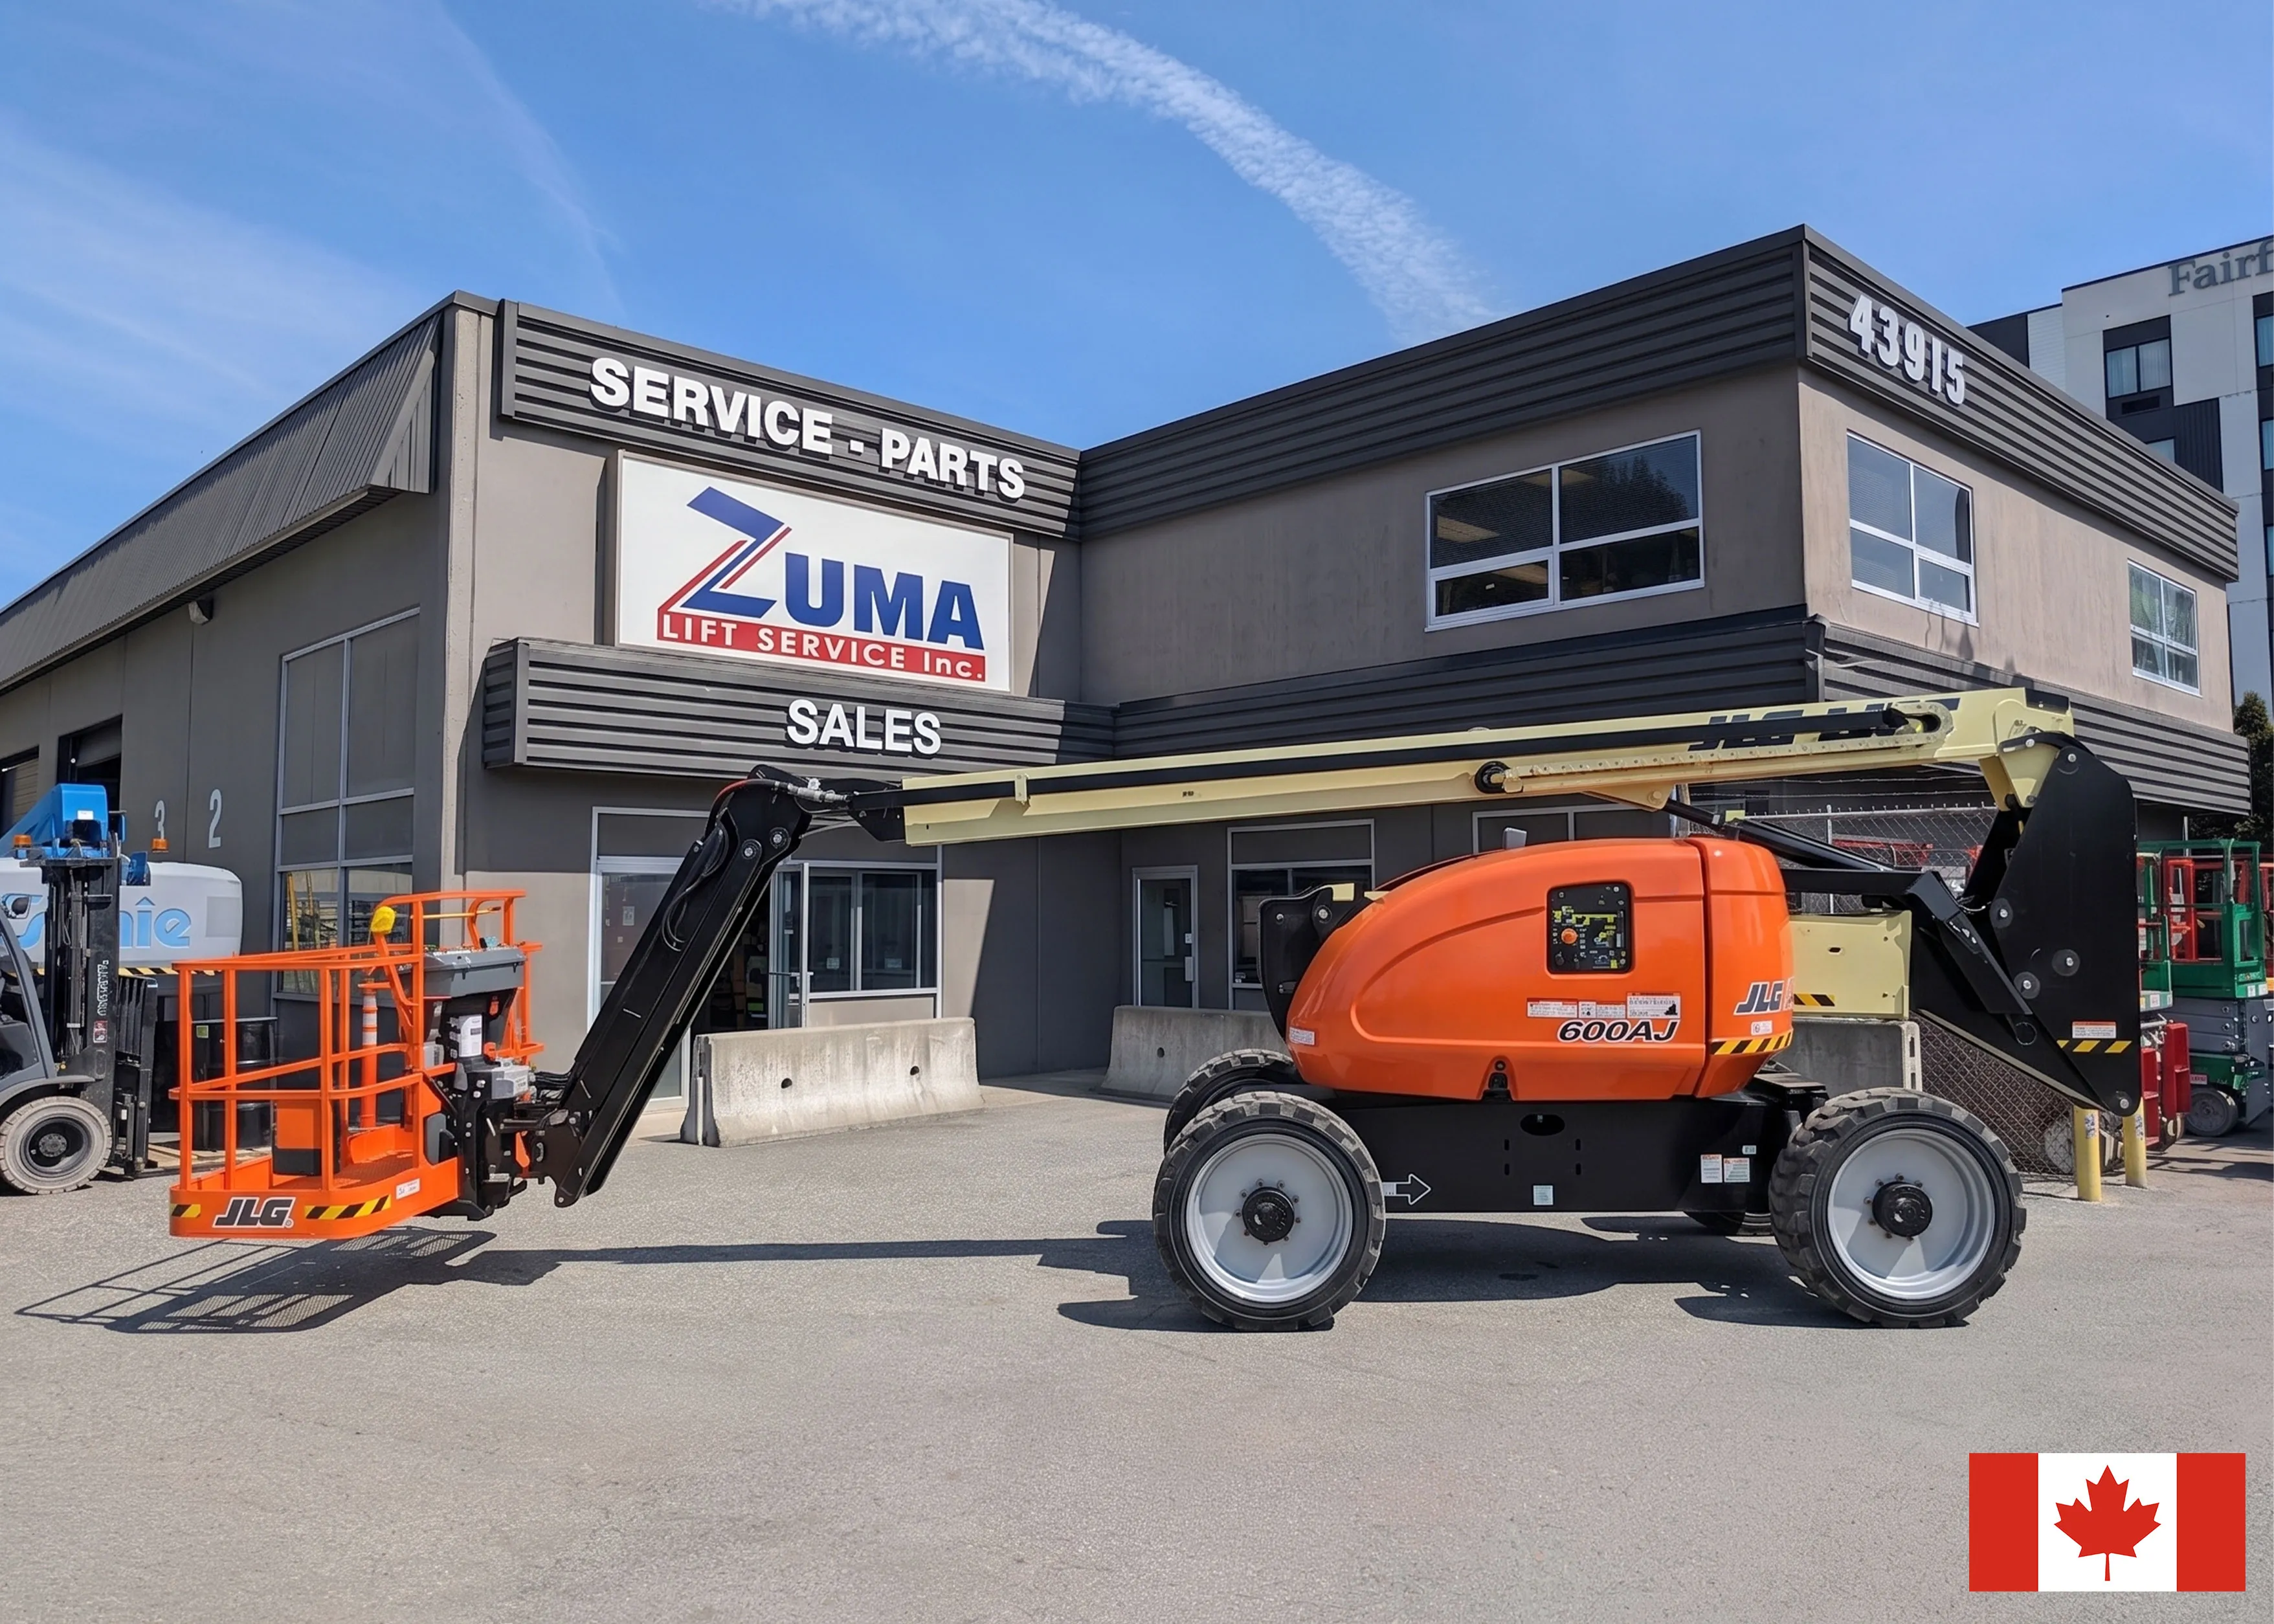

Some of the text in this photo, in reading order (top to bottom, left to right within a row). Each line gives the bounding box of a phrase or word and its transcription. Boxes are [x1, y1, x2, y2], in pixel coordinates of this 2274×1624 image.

[2168, 239, 2273, 296] Fairf
[1849, 293, 1966, 405] 43915
[590, 357, 834, 456] SERVICE
[881, 427, 1025, 499] PARTS
[681, 486, 985, 651] ZUMA
[663, 614, 983, 680] LIFT SERVICE Inc.
[786, 699, 942, 755] SALES
[208, 788, 222, 849] 2
[1733, 981, 1785, 1016] JLG
[1557, 1019, 1680, 1043] 600AJ
[212, 1197, 296, 1228] JLG
